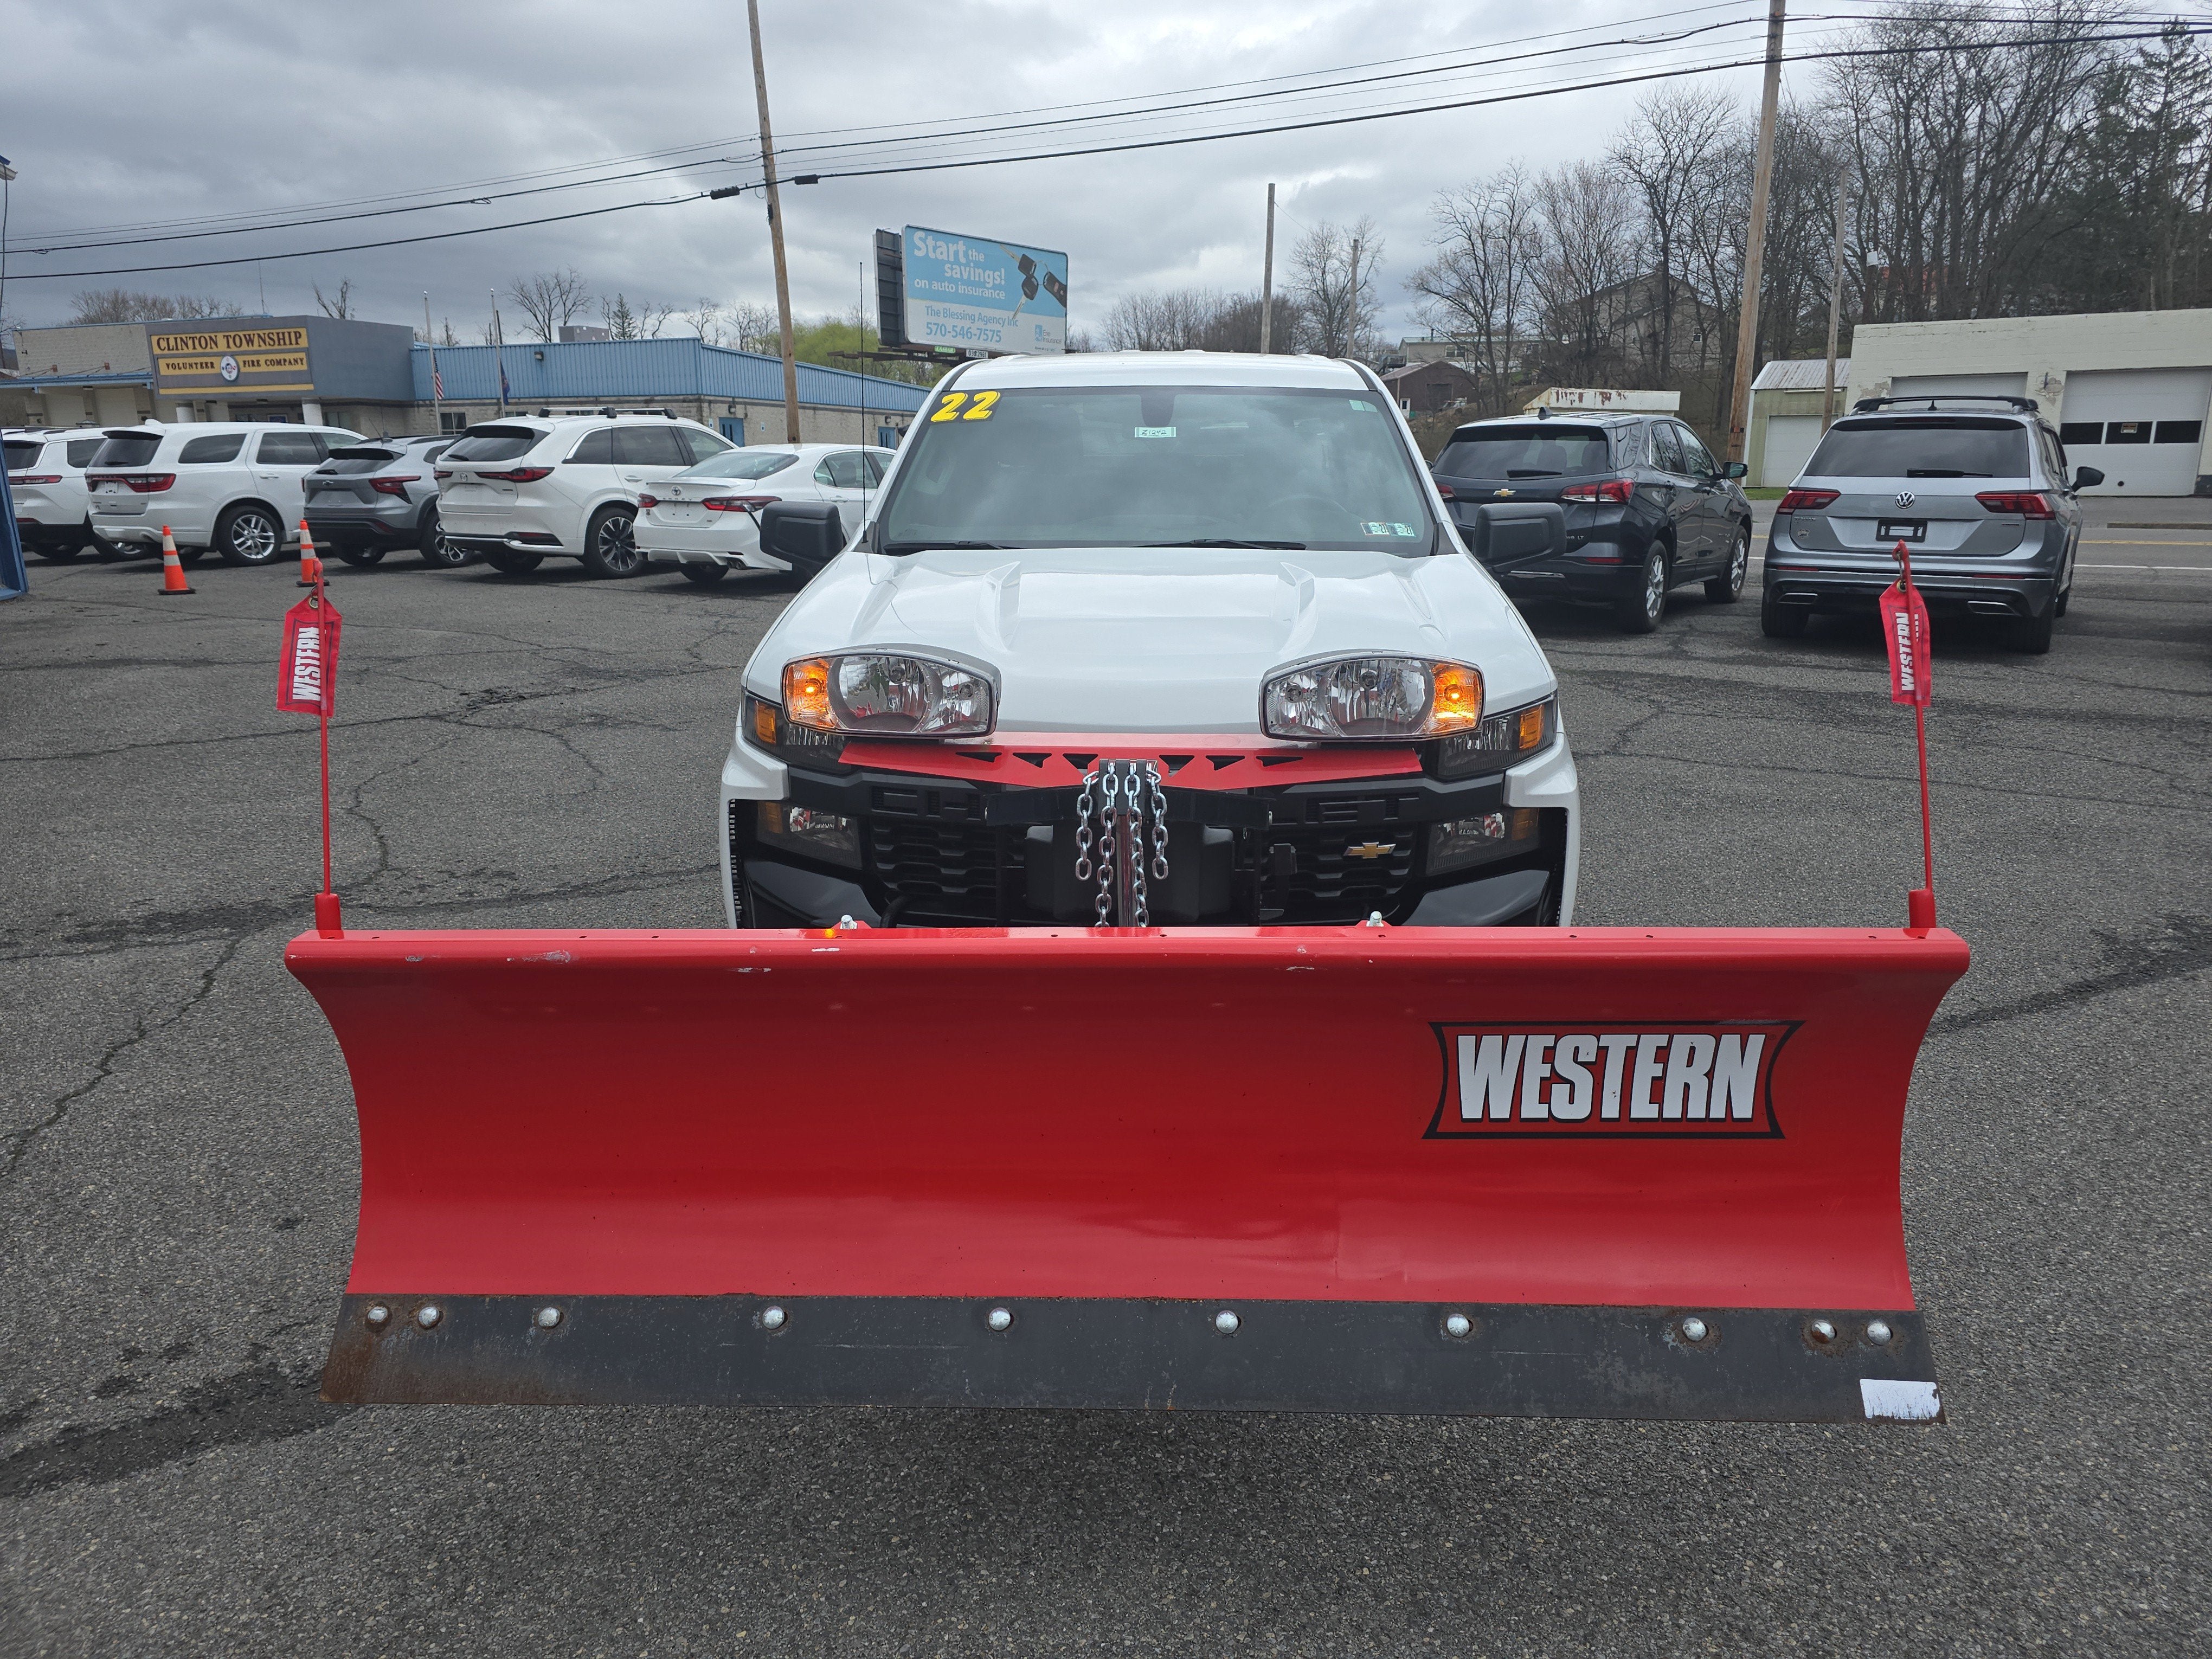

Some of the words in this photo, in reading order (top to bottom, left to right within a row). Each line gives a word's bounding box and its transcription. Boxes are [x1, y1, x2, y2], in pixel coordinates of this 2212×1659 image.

[914, 231, 966, 263] Start
[968, 248, 985, 262] the
[944, 262, 1005, 287] savings!
[915, 279, 929, 288] on
[931, 281, 956, 292] auto
[959, 282, 1006, 299] insurance
[925, 305, 940, 317] The
[943, 307, 975, 324] Blessing
[978, 312, 1006, 327] Agency
[1007, 316, 1019, 327] Inc
[157, 335, 218, 351] CLINTON
[223, 331, 302, 349] TOWNSHIP
[926, 321, 1002, 343] 570-546-7575
[165, 361, 215, 370] VOLUNTEER
[242, 359, 261, 368] FIRE
[265, 357, 305, 366] COMPANY
[931, 391, 1001, 422] 22
[1457, 1034, 1766, 1122] WESTERN
